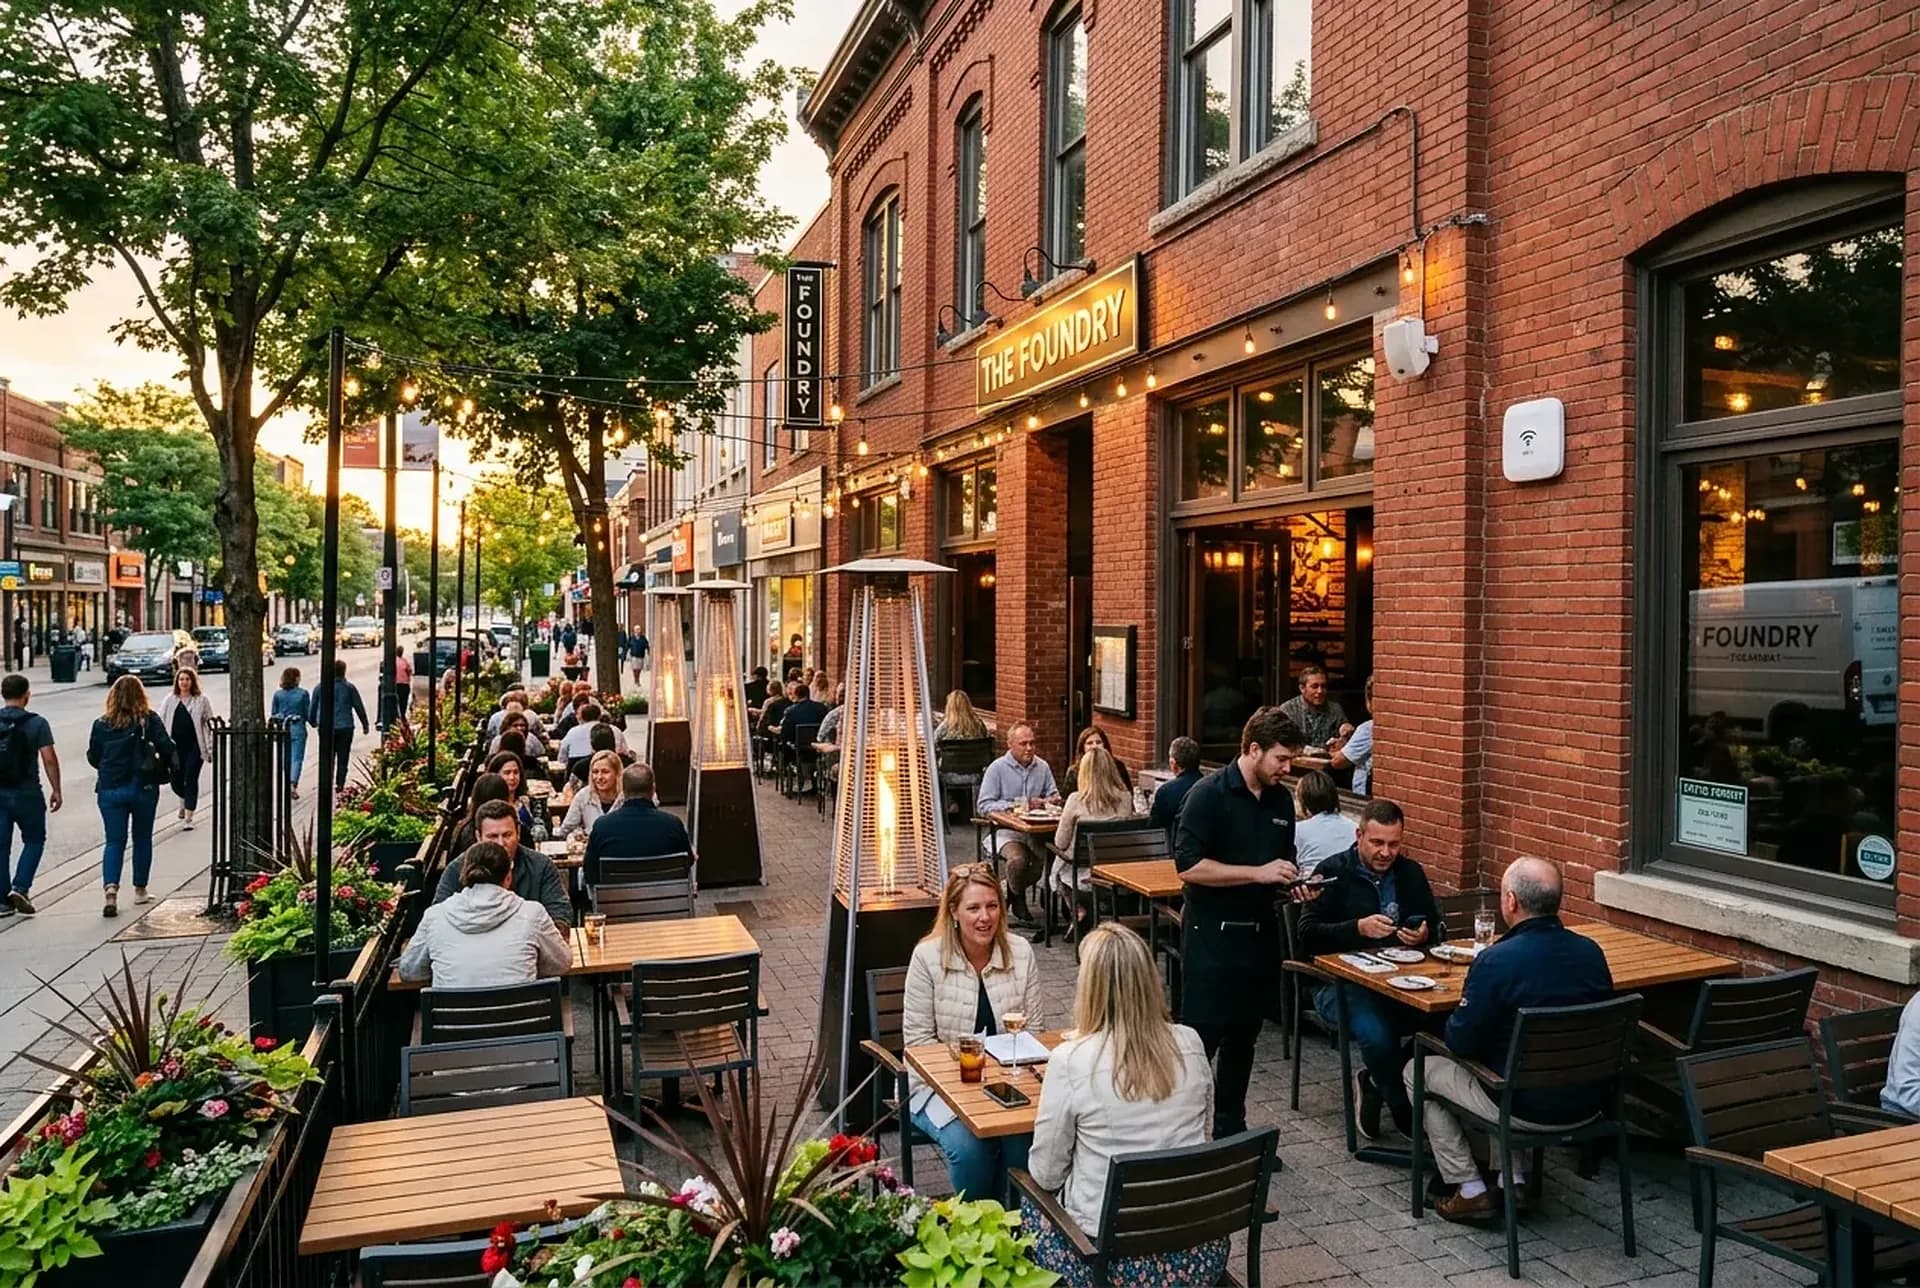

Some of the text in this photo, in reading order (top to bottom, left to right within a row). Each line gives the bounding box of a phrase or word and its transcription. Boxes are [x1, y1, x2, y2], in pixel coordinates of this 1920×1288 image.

[796, 285, 813, 415] FOUNDRY
[981, 288, 1126, 394] THE FOUNDRY
[1702, 624, 1819, 648] FOUNDRY
